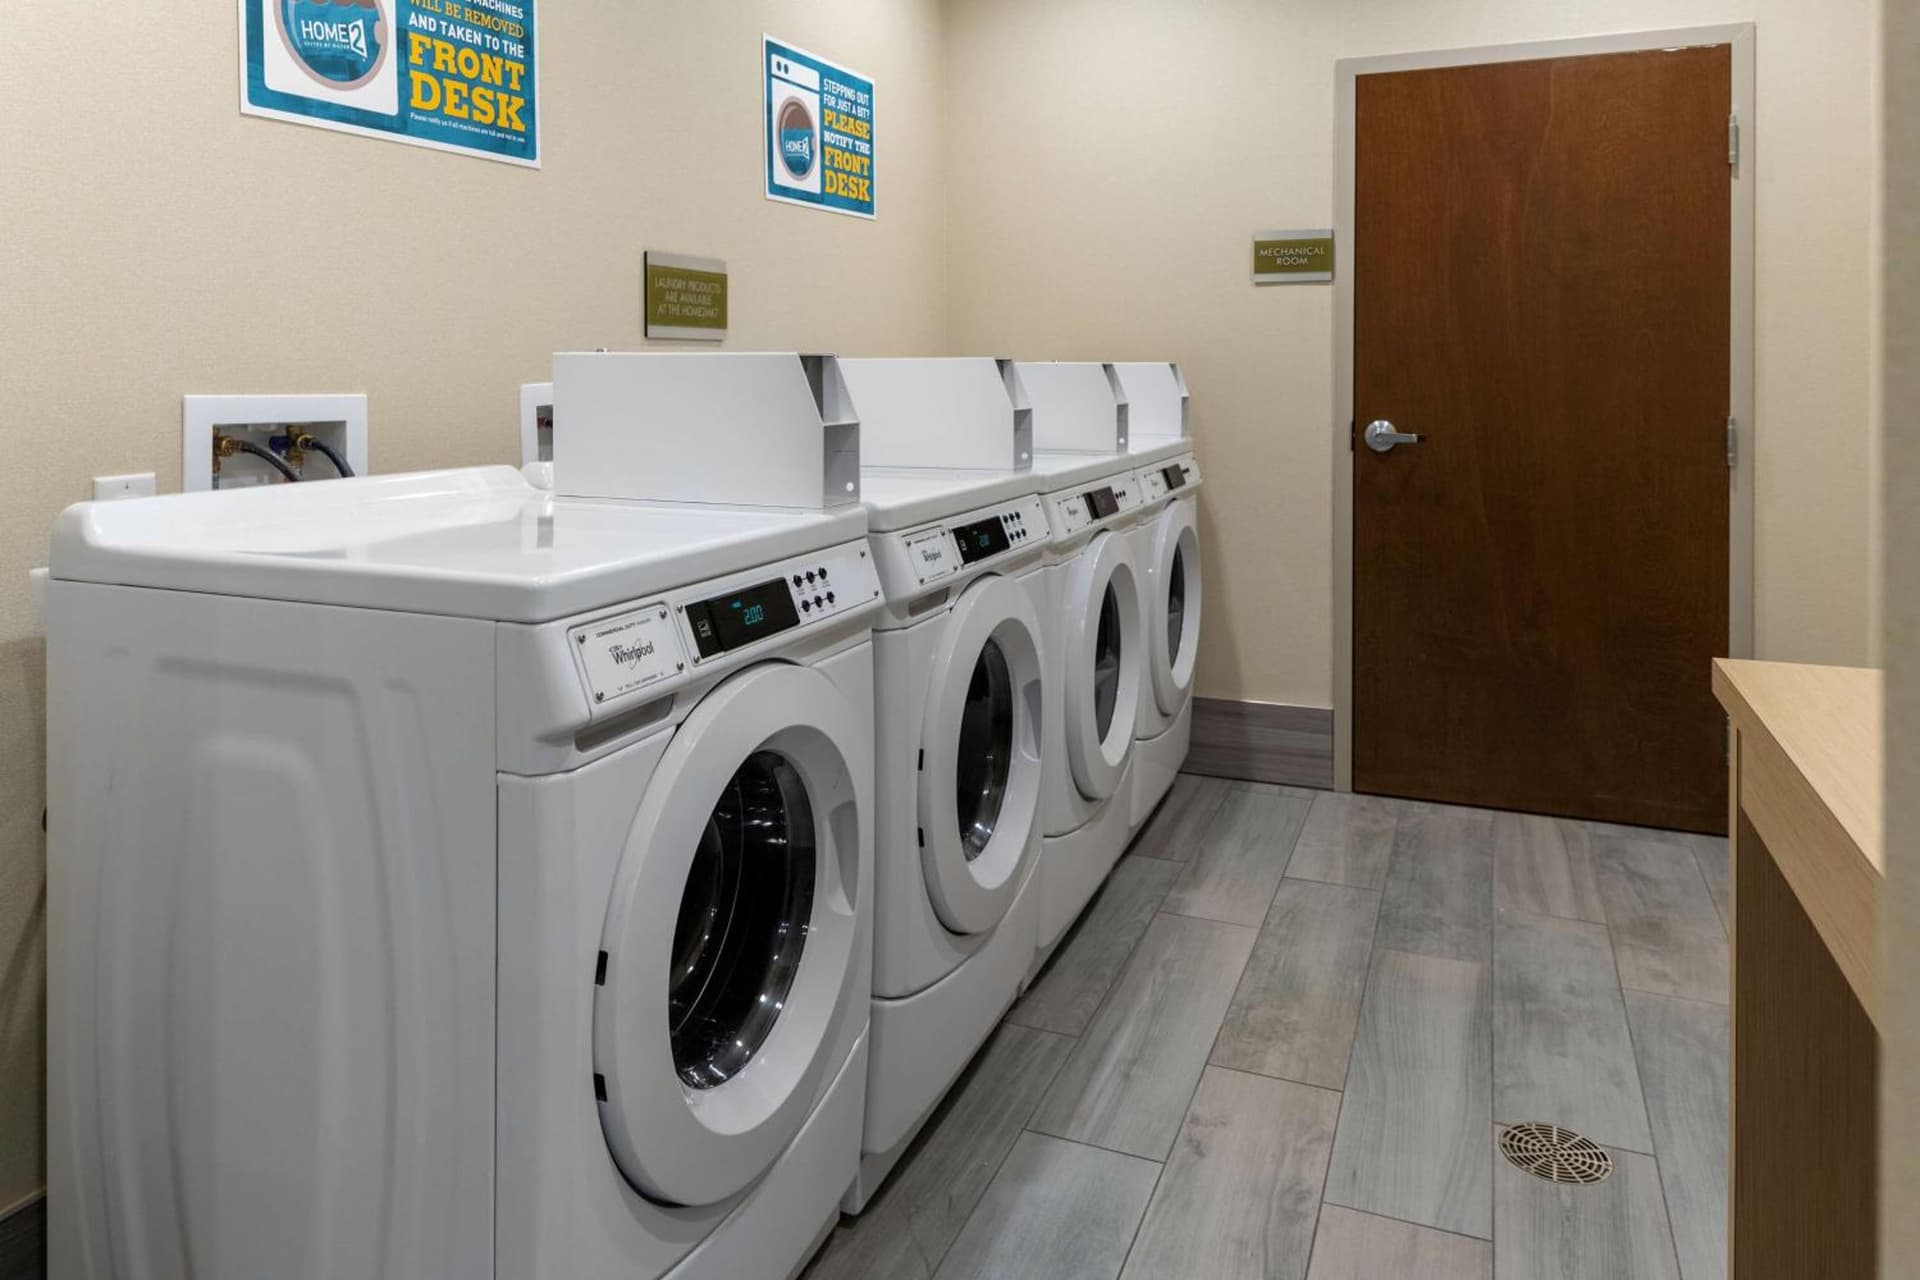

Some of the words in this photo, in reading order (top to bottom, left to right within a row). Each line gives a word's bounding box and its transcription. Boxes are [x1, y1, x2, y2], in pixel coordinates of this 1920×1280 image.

[408, 11, 437, 32] AND
[440, 20, 482, 46] TAKEN
[485, 34, 500, 51] TO
[502, 39, 525, 58] THE
[445, 1, 461, 19] BE
[464, 8, 524, 38] REMOVED
[408, 31, 525, 92] FRONT
[409, 70, 526, 132] DESK
[824, 78, 856, 101] STEPPING
[857, 91, 869, 106] OUT
[824, 93, 837, 108] FOR
[837, 98, 851, 114] JUST
[852, 104, 857, 115] A
[857, 105, 870, 120] BIT?
[824, 108, 870, 140] PLEASE
[824, 130, 854, 149] NOTIFY
[855, 140, 871, 155] THE
[824, 146, 870, 177] FRONT
[825, 169, 871, 202] DESK
[1259, 247, 1325, 256] MECHANICAL
[1276, 256, 1308, 265] ROOM
[610, 640, 655, 665] Whirlpool
